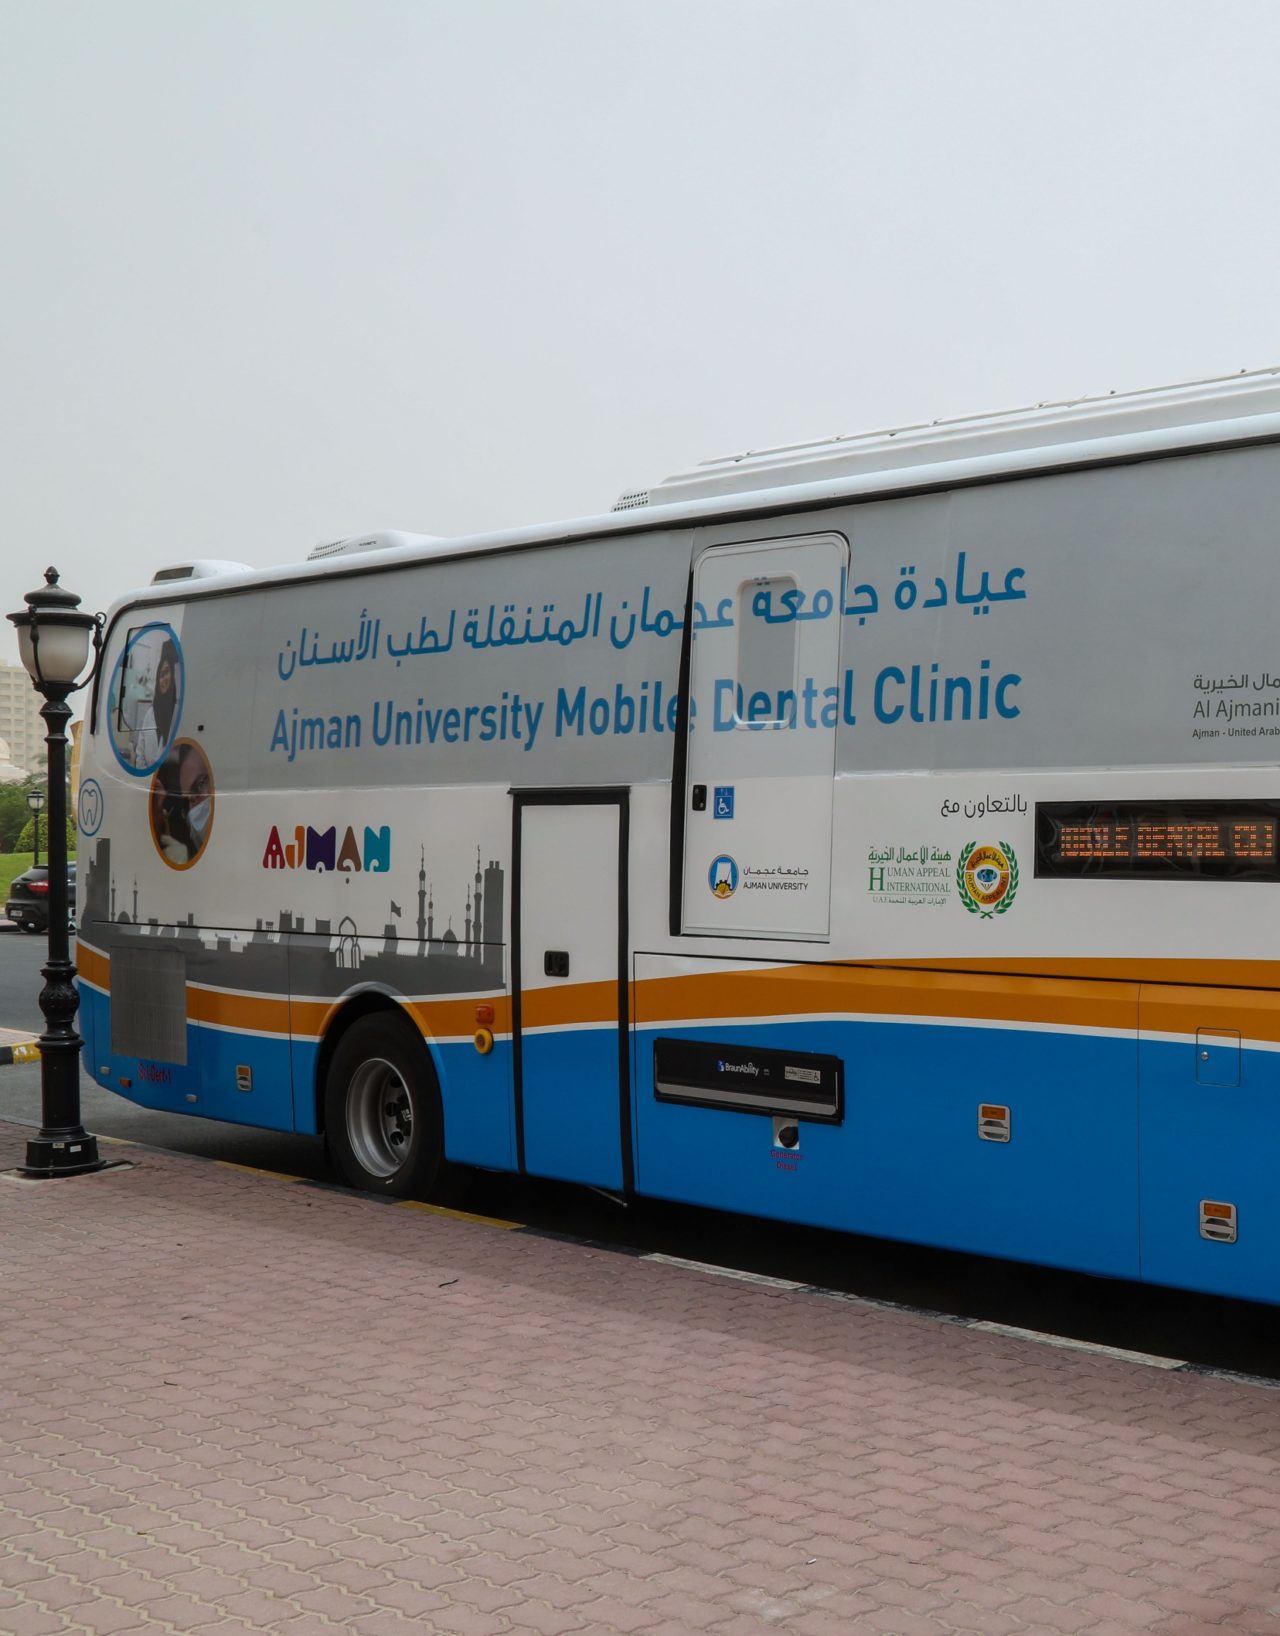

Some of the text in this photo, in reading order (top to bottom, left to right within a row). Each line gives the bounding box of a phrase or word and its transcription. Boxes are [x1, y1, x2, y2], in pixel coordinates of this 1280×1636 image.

[894, 551, 1027, 616] عيادة
[463, 591, 603, 649] المتنقلة
[277, 607, 381, 681] الأسنان
[386, 609, 456, 668] لطب
[1193, 673, 1249, 694] الخيرية
[269, 659, 1023, 762] Ajman University Mobile Dental Clinic
[1193, 700, 1211, 719] Al
[1213, 698, 1280, 723] Ajmani
[1192, 726, 1220, 739] Ajman
[1228, 726, 1257, 738] United
[1258, 726, 1280, 737] Arab
[940, 794, 1028, 819] بالتعاون مع
[262, 825, 391, 873] AJMAN
[868, 846, 894, 864] الخيرية
[930, 847, 952, 864] هيئة
[743, 866, 809, 877] جامعة عجمان
[916, 868, 951, 877] APPEAL
[743, 880, 809, 891] AJMAN UNIVERSITY
[886, 881, 951, 893] INTERNATIONAL
[967, 873, 981, 898] HUMAN
[725, 1062, 760, 1077] BraunAbility
